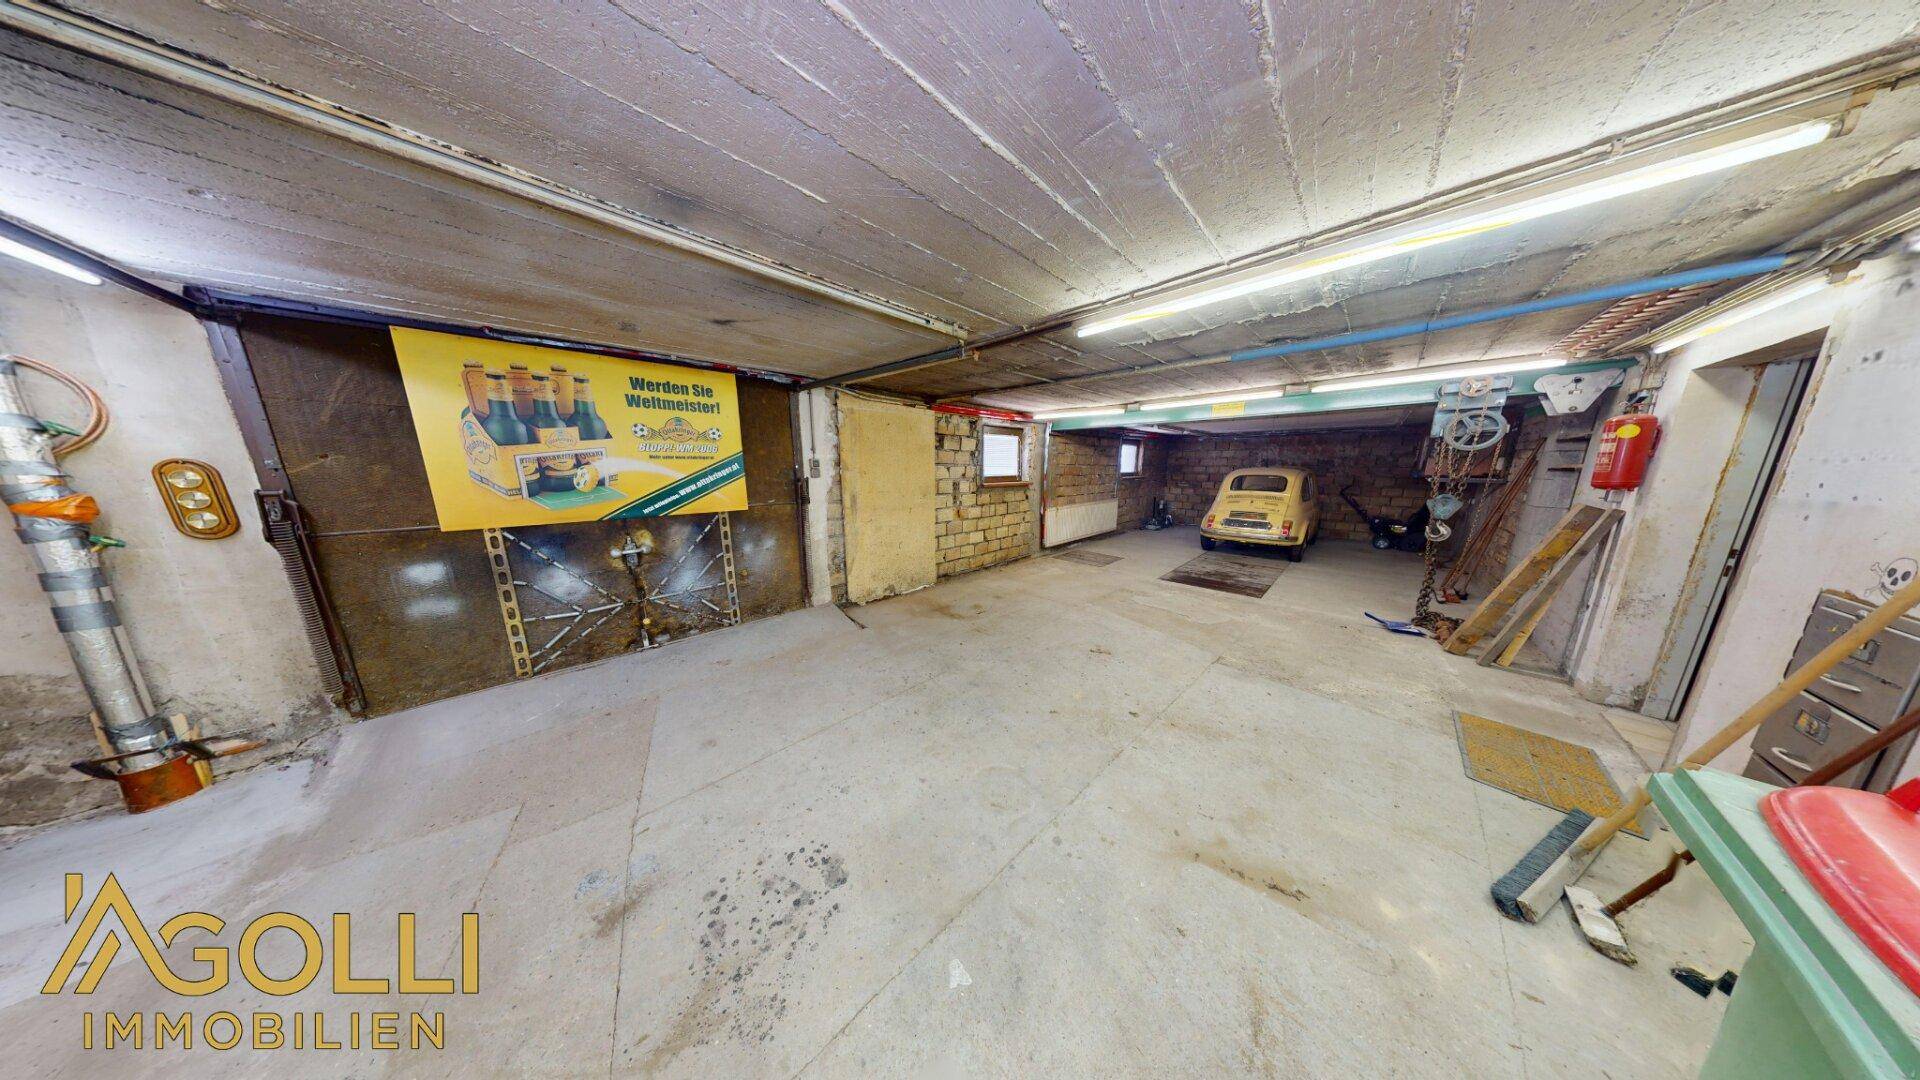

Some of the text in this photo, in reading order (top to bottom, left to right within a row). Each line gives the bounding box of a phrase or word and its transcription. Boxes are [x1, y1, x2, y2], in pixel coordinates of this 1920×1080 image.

[629, 376, 714, 399] Werden Sie
[625, 393, 721, 414] Weltmeister!
